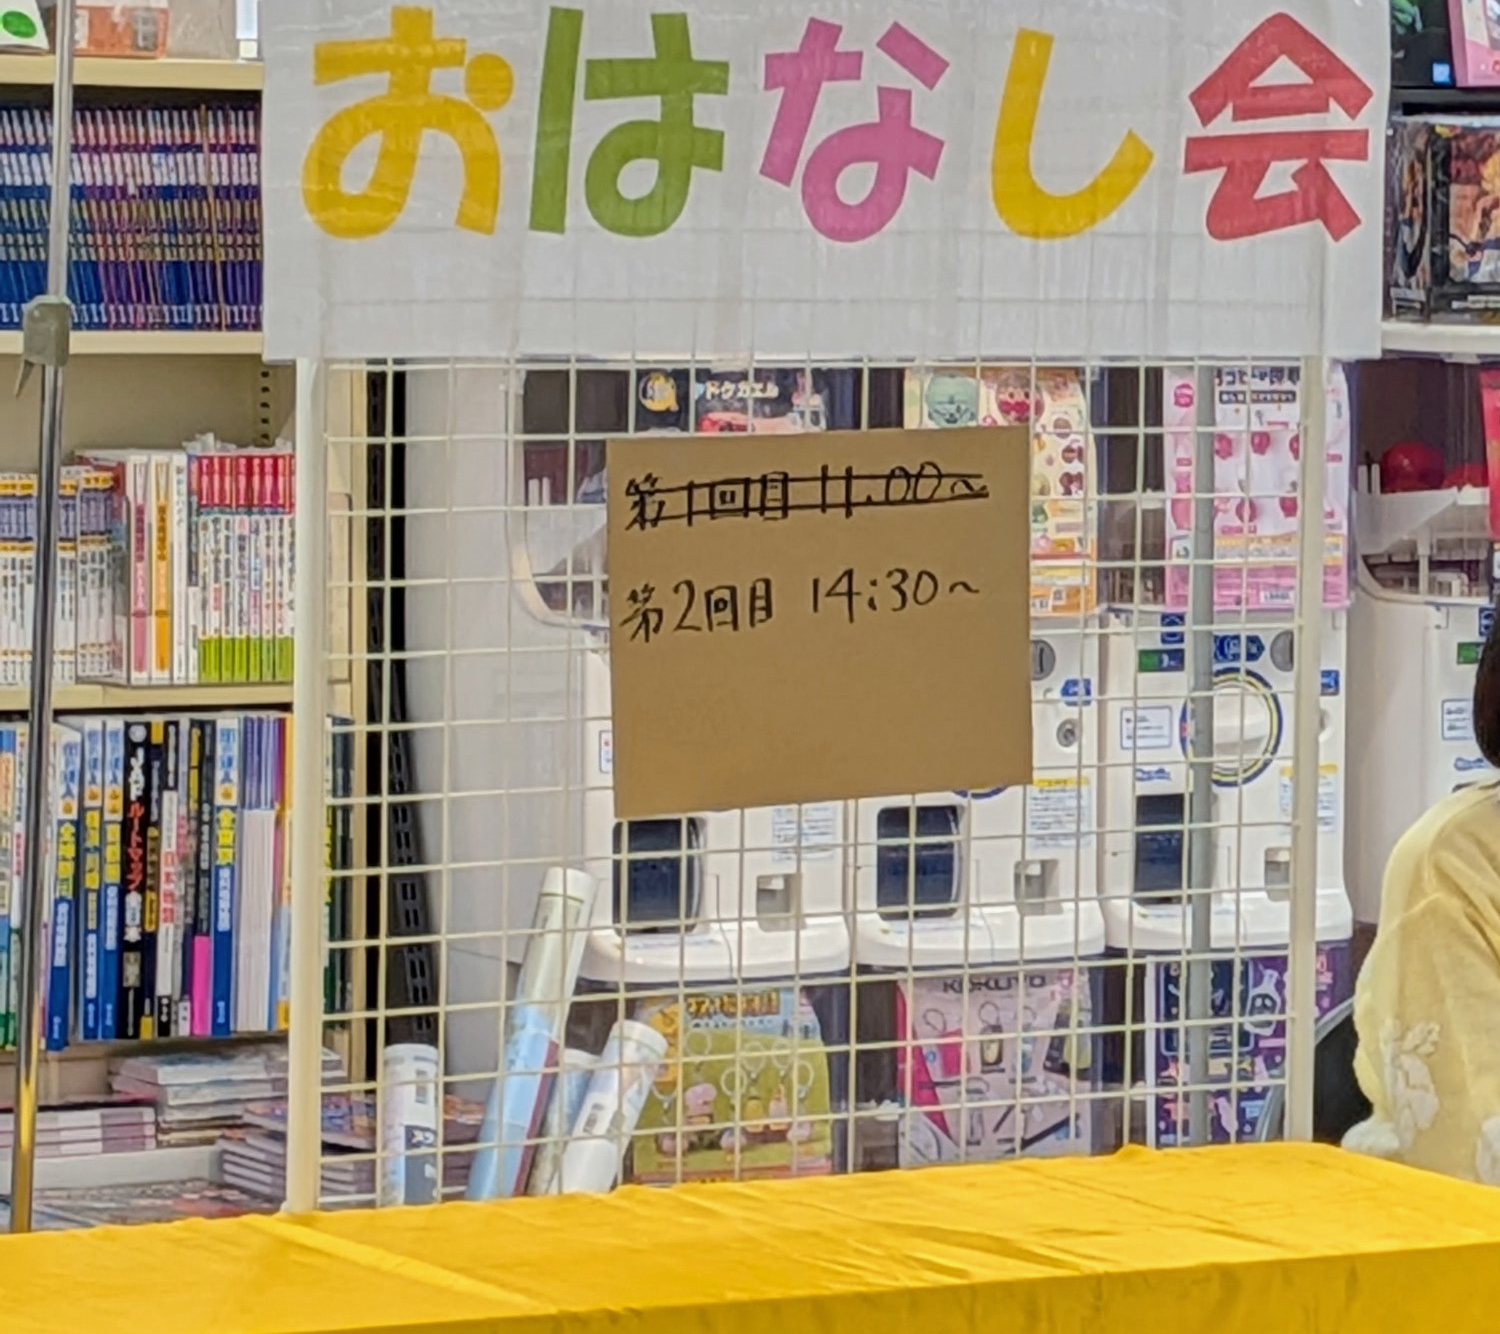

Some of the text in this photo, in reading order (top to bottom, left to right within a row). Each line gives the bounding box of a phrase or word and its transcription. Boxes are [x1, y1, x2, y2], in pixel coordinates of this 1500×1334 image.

[302, 6, 1372, 243] おはなし会
[620, 577, 774, 643] 第2回目
